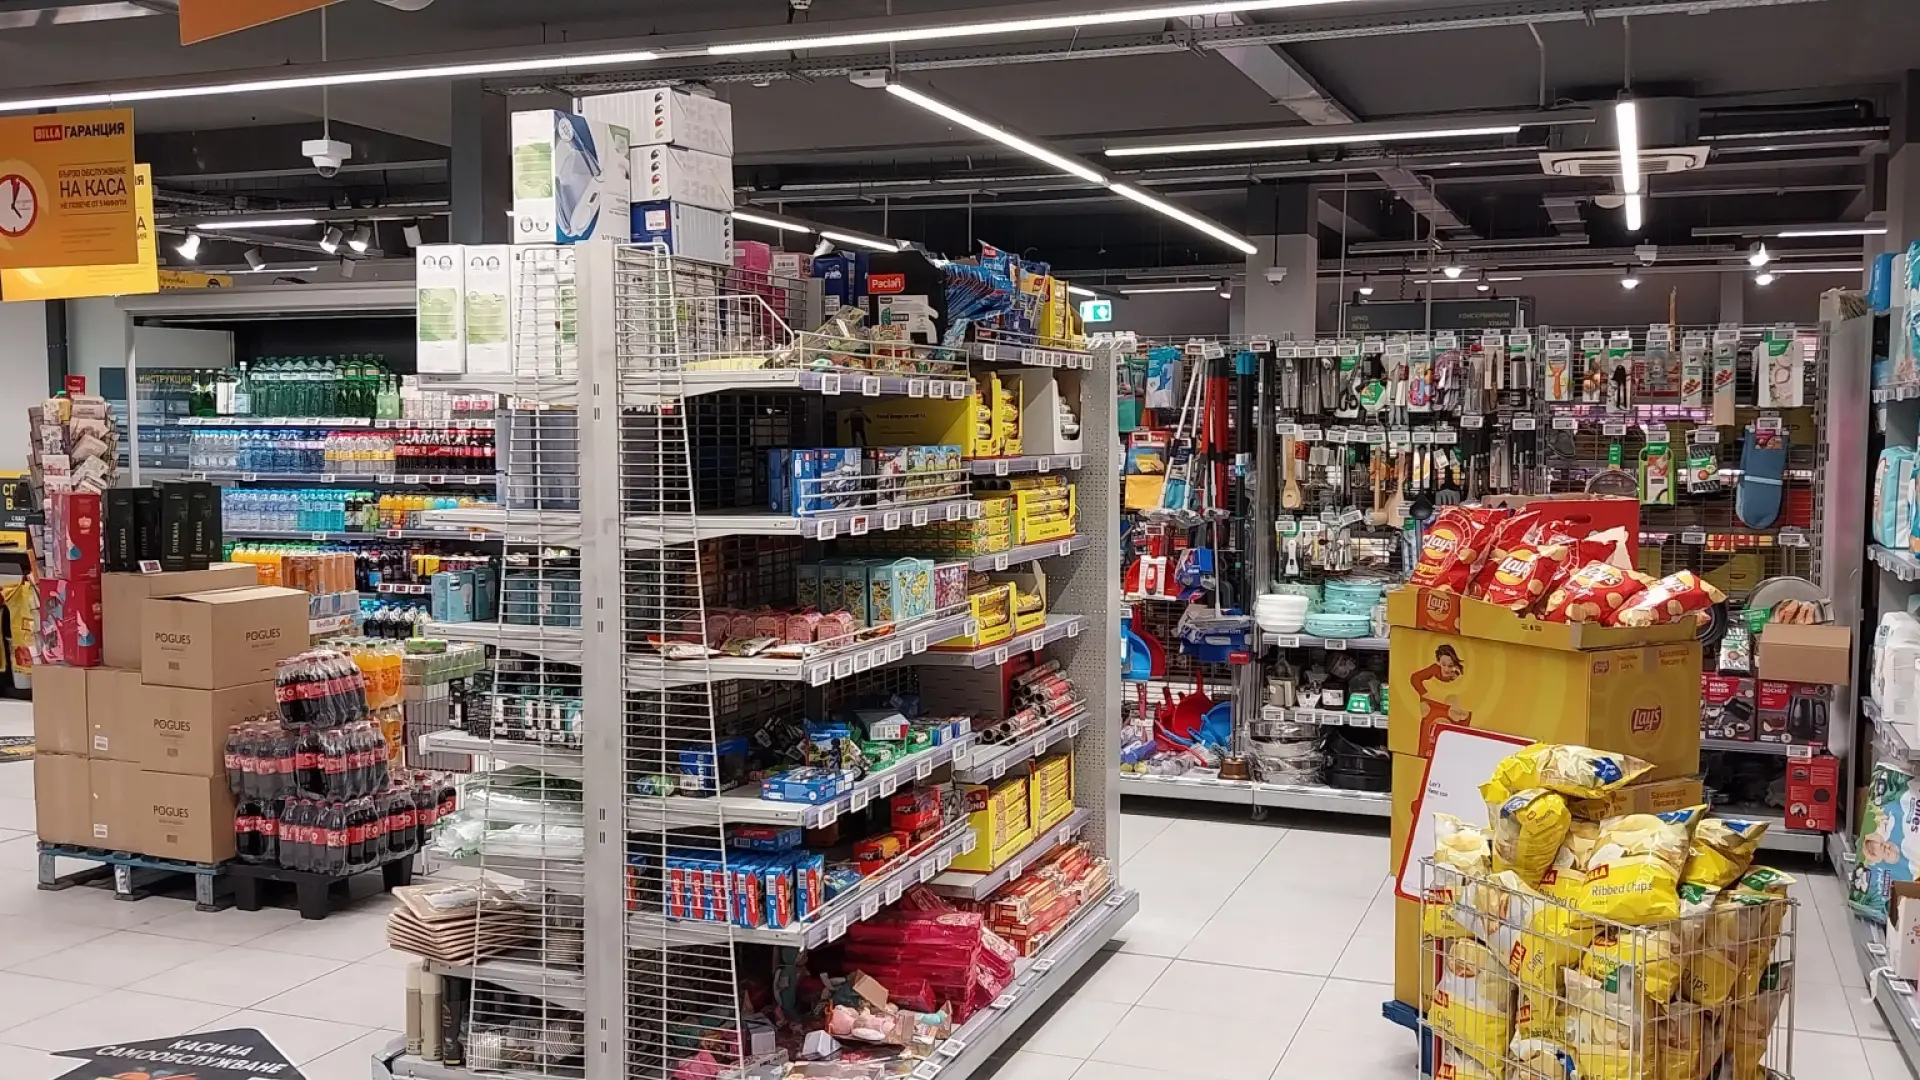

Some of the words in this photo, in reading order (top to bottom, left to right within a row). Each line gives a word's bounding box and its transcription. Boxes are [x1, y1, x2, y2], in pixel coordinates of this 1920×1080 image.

[34, 127, 61, 140] BILLA
[64, 122, 125, 139] ГАРАНЦИЯ
[60, 180, 82, 198] НА
[85, 177, 126, 196] КАСА
[872, 277, 901, 288] Paclan
[140, 374, 192, 384] ИНСТРУКЦИЯ
[155, 632, 191, 645] POGUES
[245, 628, 281, 642] POGUES
[154, 719, 190, 732] POGUES
[154, 805, 189, 818] POGUES
[1592, 884, 1625, 896] Ribbed
[1626, 880, 1652, 894] Chips
[221, 1044, 254, 1056] НА
[95, 1046, 288, 1074] САМООБСЛУЖВАНЕ
